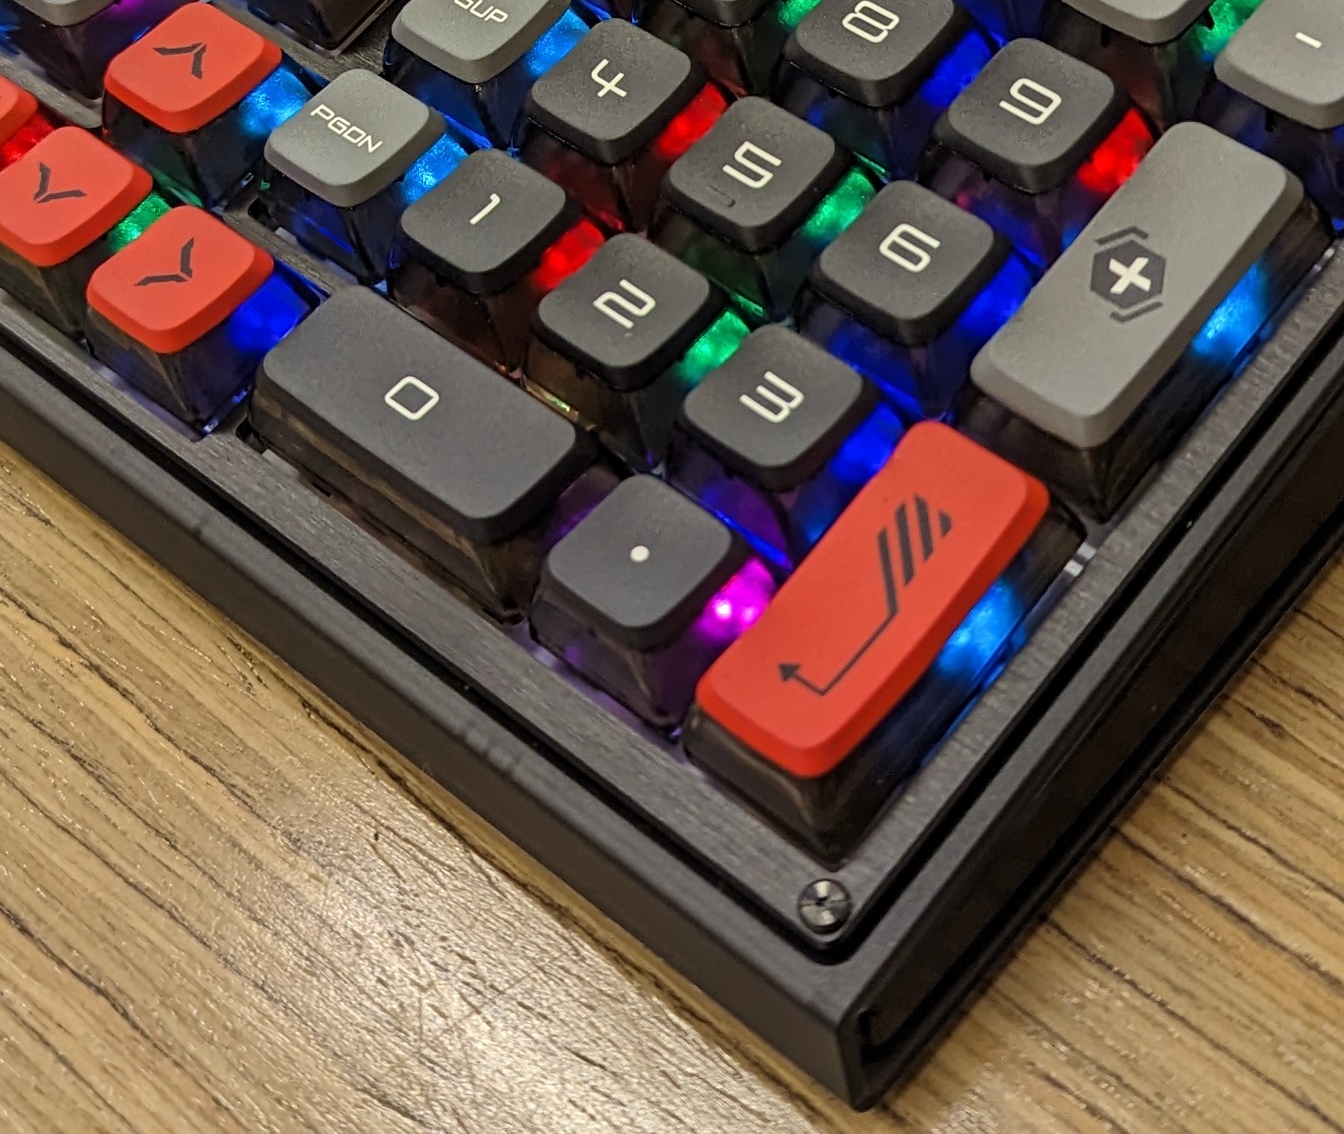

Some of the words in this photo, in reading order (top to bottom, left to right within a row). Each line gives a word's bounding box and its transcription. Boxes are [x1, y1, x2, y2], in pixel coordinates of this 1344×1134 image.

[841, 0, 901, 45] 8
[590, 58, 629, 100] 4
[998, 77, 1064, 127] 9
[309, 102, 384, 156] PGDN
[722, 140, 783, 191] 5
[470, 192, 502, 227] 1
[878, 222, 942, 274] 6
[592, 278, 657, 330] 2
[384, 375, 441, 422] 0
[738, 370, 806, 425] 3
